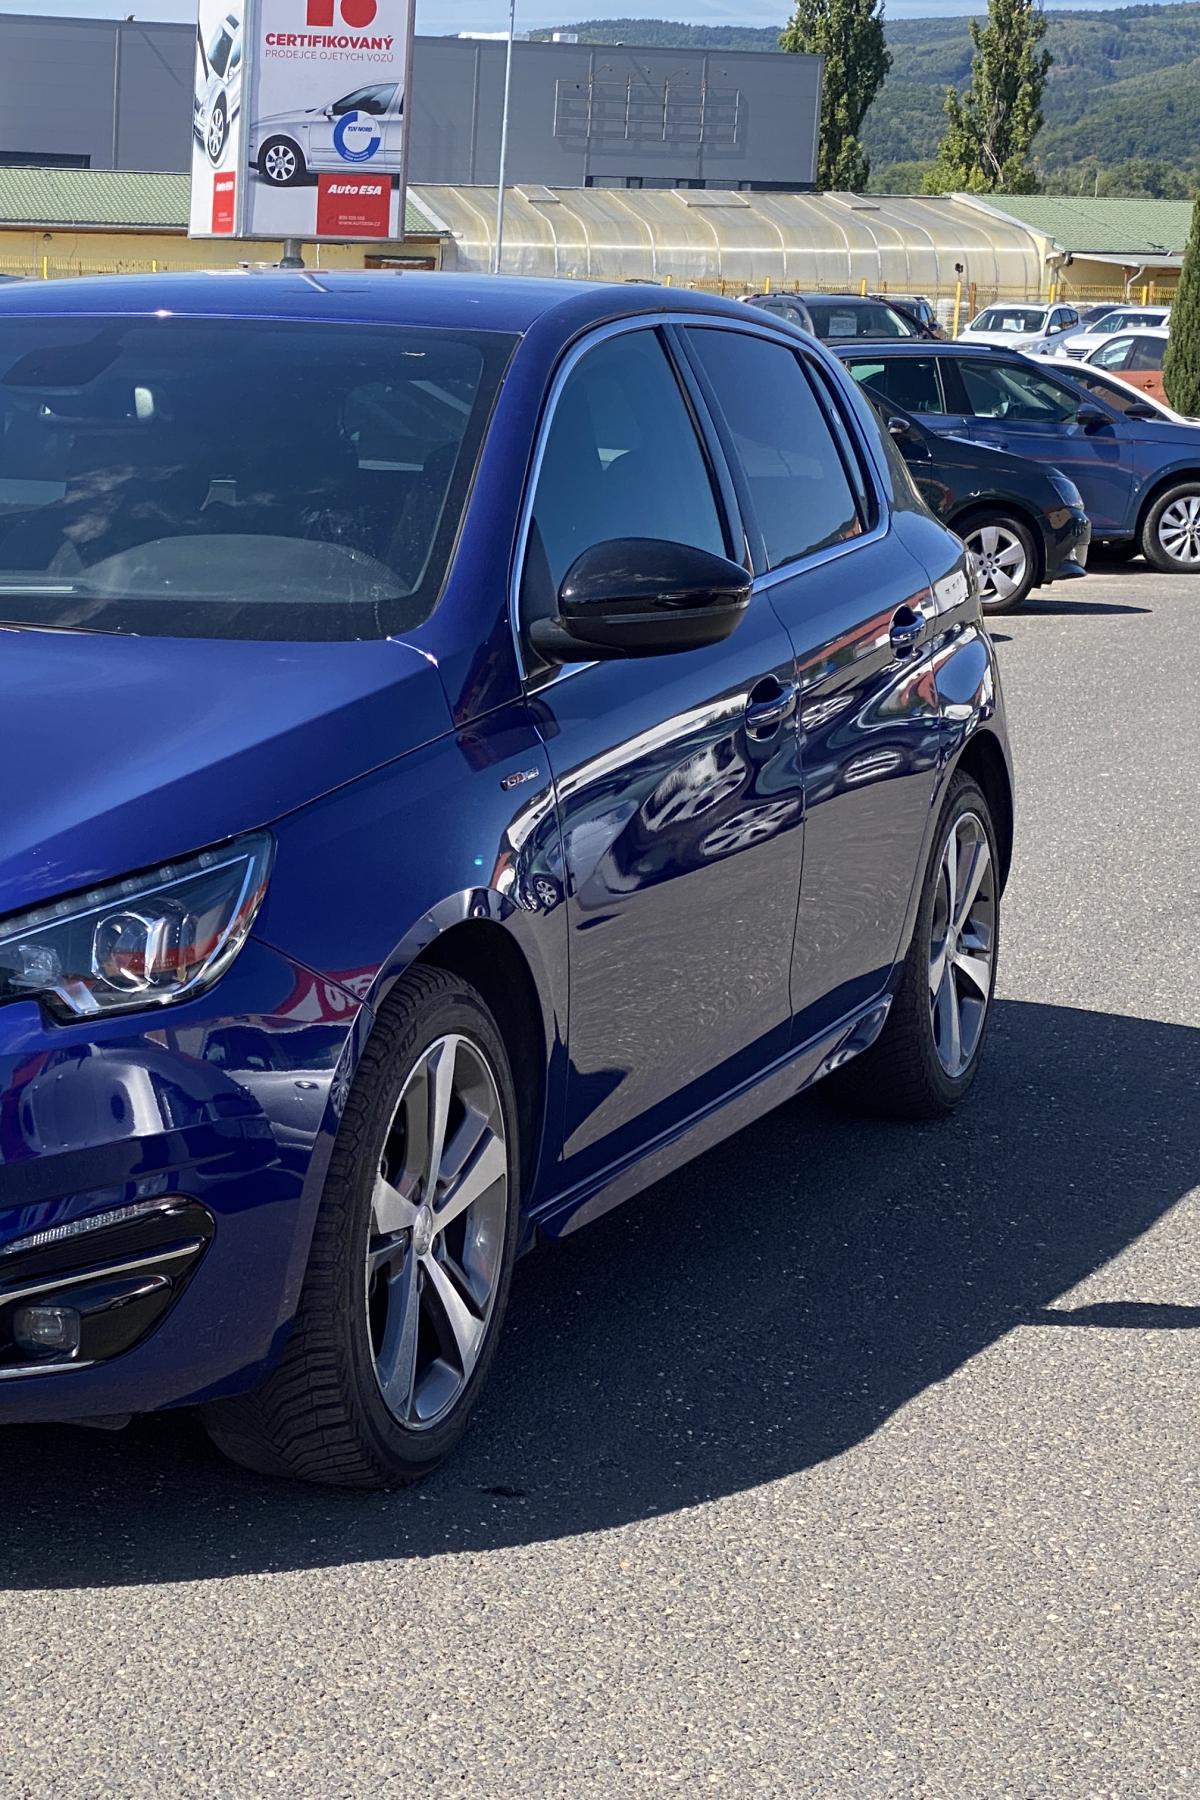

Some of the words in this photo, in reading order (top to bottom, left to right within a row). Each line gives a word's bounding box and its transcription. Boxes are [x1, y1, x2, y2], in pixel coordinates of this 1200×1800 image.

[265, 33, 394, 50] CERTIFIKOVANÝ
[265, 49, 317, 60] PRODEJCE
[320, 50, 364, 61] OJETÝCH
[328, 184, 359, 195] Auto
[359, 185, 382, 195] ESA
